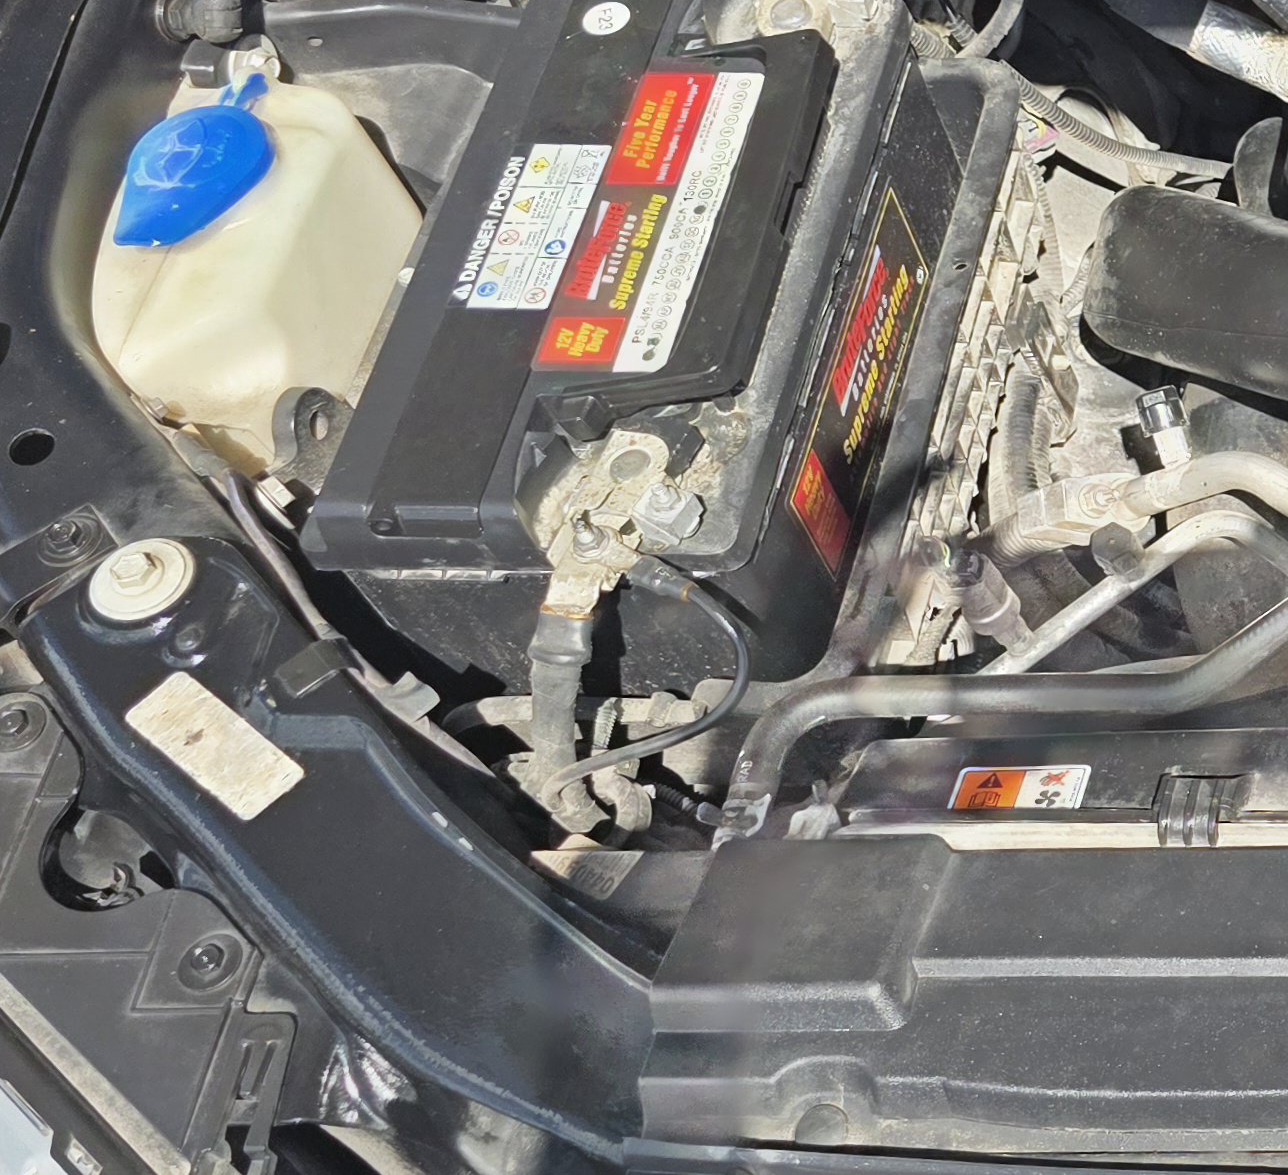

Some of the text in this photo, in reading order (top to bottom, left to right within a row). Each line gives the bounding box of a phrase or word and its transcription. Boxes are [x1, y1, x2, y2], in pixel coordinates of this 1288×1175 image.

[598, 7, 614, 31] F23
[623, 99, 658, 158] Five Year
[636, 89, 678, 169] Performance
[458, 219, 500, 282] DANGER
[601, 214, 638, 284] Batteries
[608, 193, 668, 310] Supreme Starting
[652, 246, 674, 286] 750CCA
[683, 169, 702, 201] 130RC
[556, 328, 575, 349] 12V
[568, 321, 595, 357] Heavy
[585, 326, 609, 353] Duty
[843, 359, 879, 465] Supreme
[876, 264, 909, 360] Starting
[852, 294, 888, 401] Batteries
[736, 760, 754, 783] RAD
